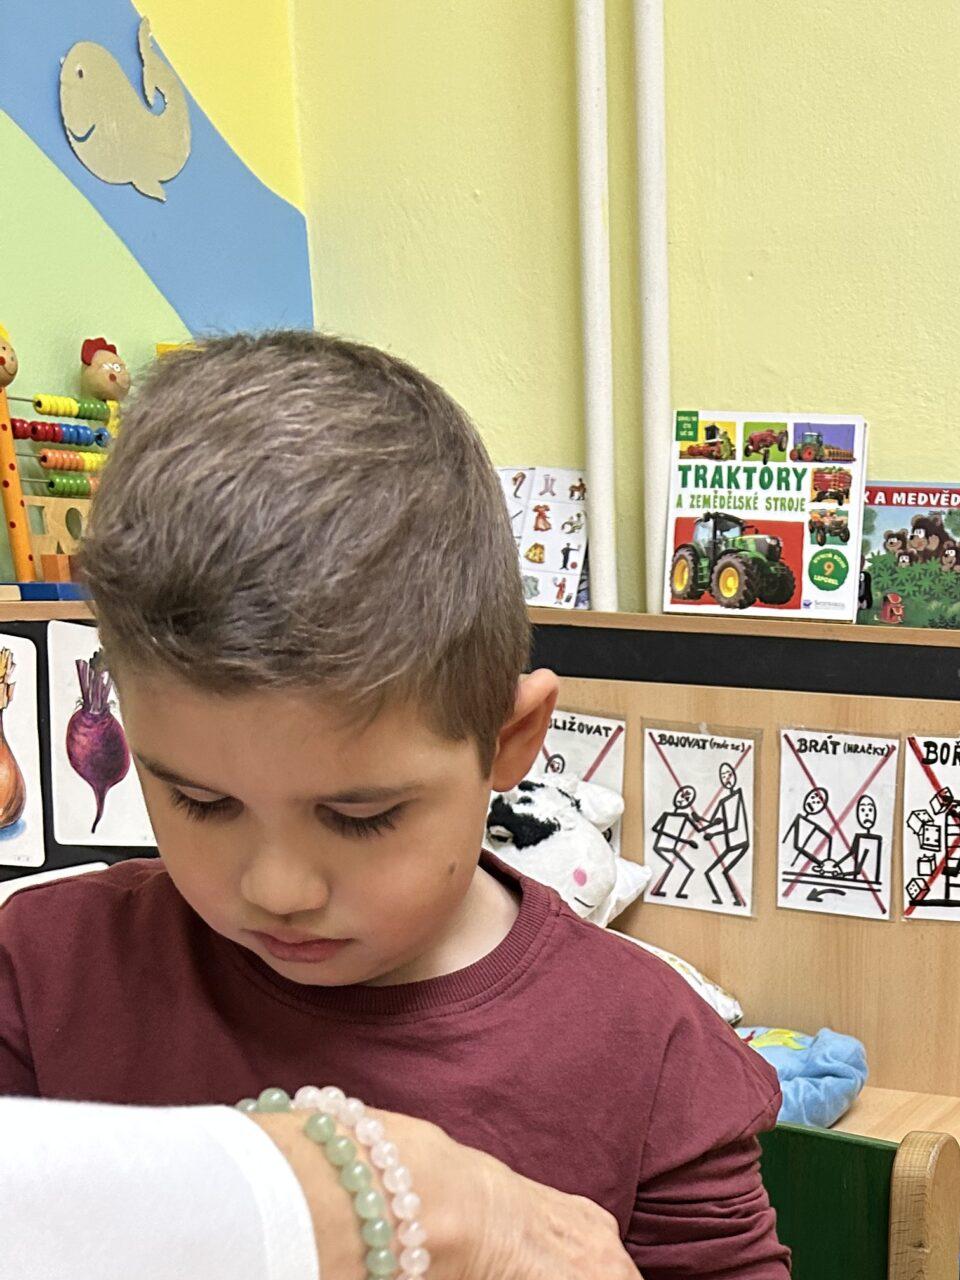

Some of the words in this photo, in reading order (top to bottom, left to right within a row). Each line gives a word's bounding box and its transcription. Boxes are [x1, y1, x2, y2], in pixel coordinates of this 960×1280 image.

[678, 464, 808, 491] TRAKTORY
[676, 494, 683, 508] A
[690, 490, 759, 511] ZEMĚDĚLSKÉ
[765, 496, 806, 512] STROJE
[876, 493, 887, 504] A
[824, 562, 835, 576] 9
[657, 734, 708, 750] BOJOVAT
[797, 735, 841, 755] BRÁT
[843, 742, 890, 757] (HRAČKY)
